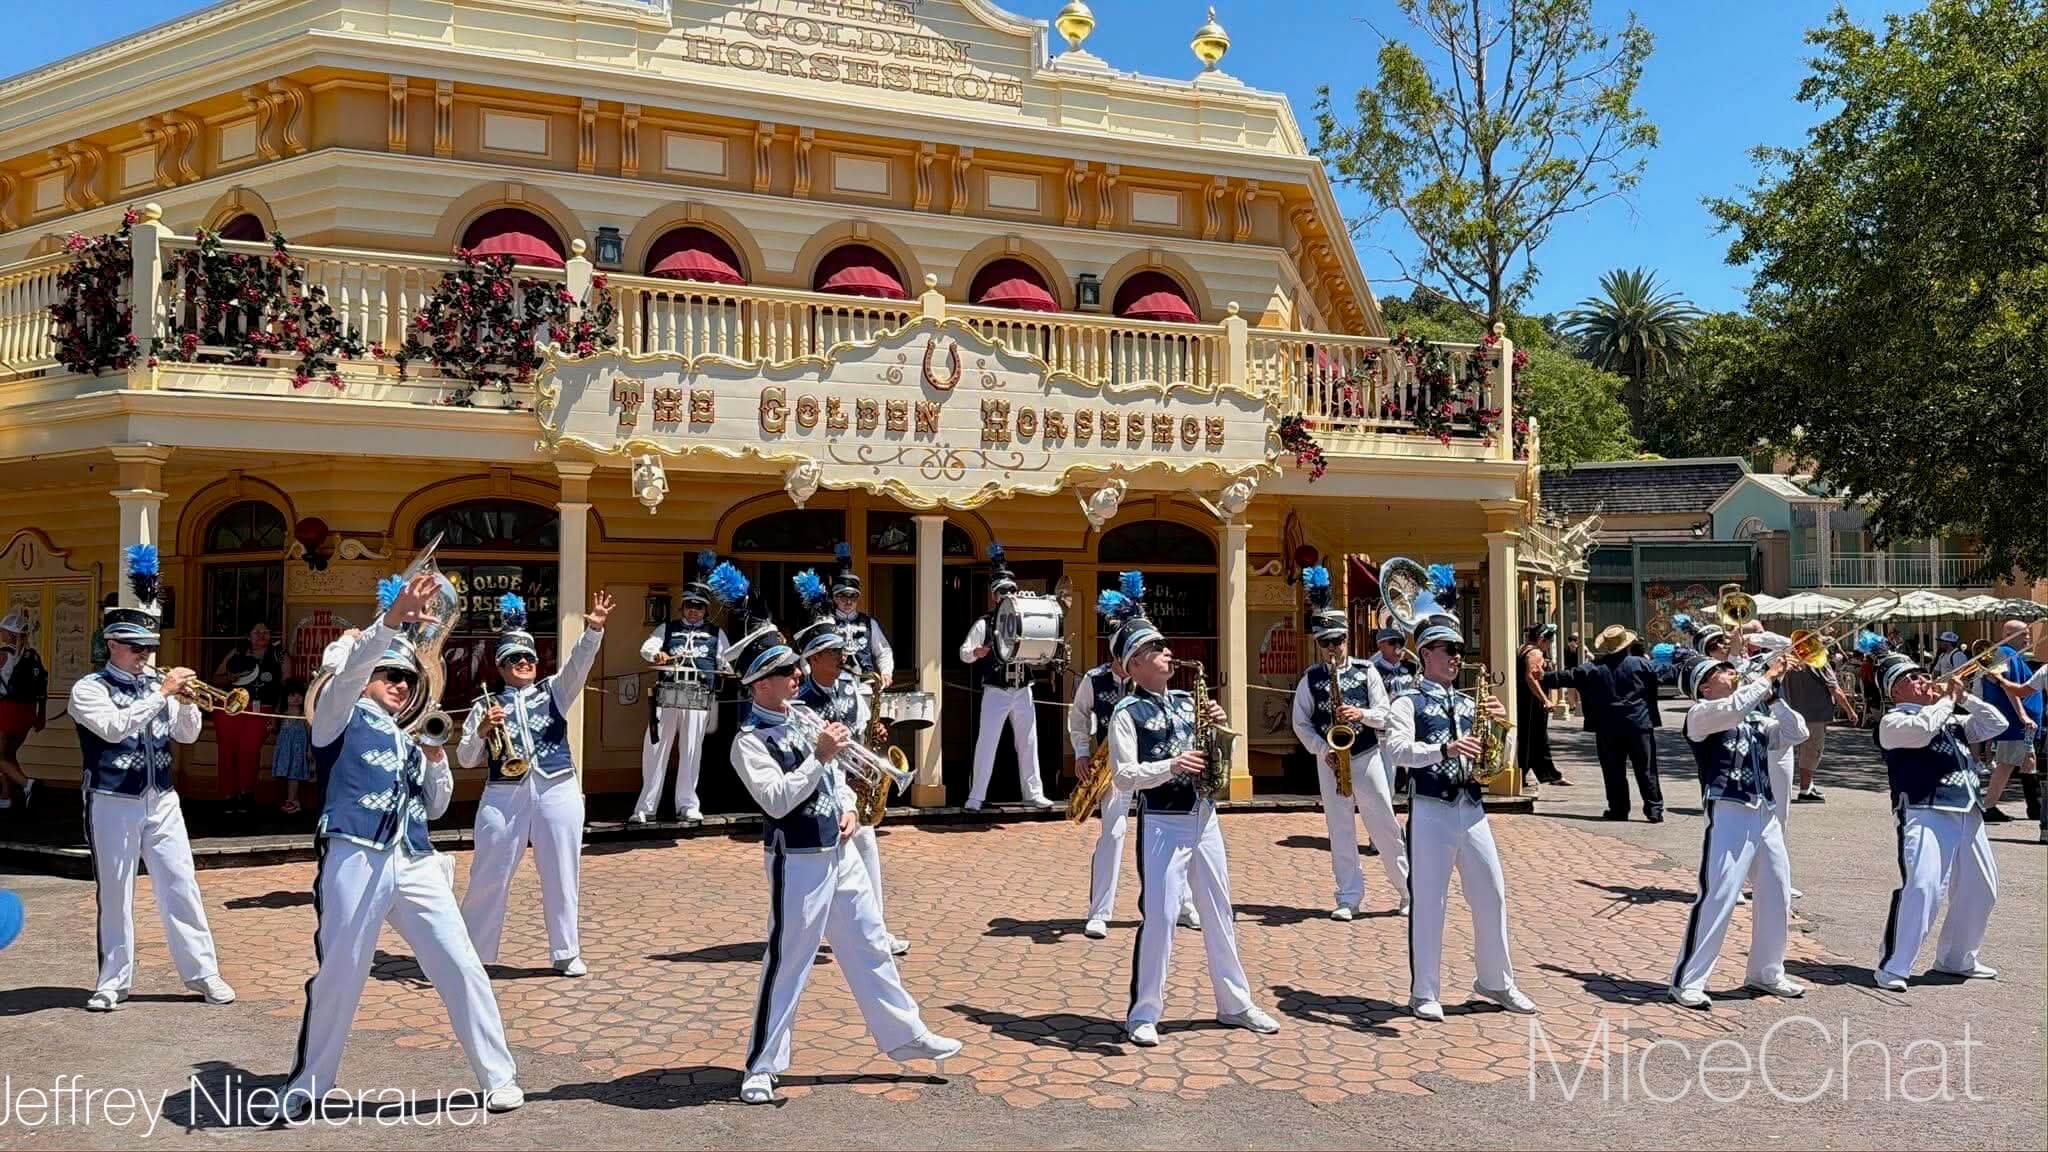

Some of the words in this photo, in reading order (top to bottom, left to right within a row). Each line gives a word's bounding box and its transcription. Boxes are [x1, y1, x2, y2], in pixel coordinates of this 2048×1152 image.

[682, 33, 1024, 108] HORSESHOE
[743, 10, 970, 67] GOLDEN
[613, 378, 715, 426] THE
[759, 386, 942, 434] GOLDEN
[981, 399, 1225, 446] HORSESHOE
